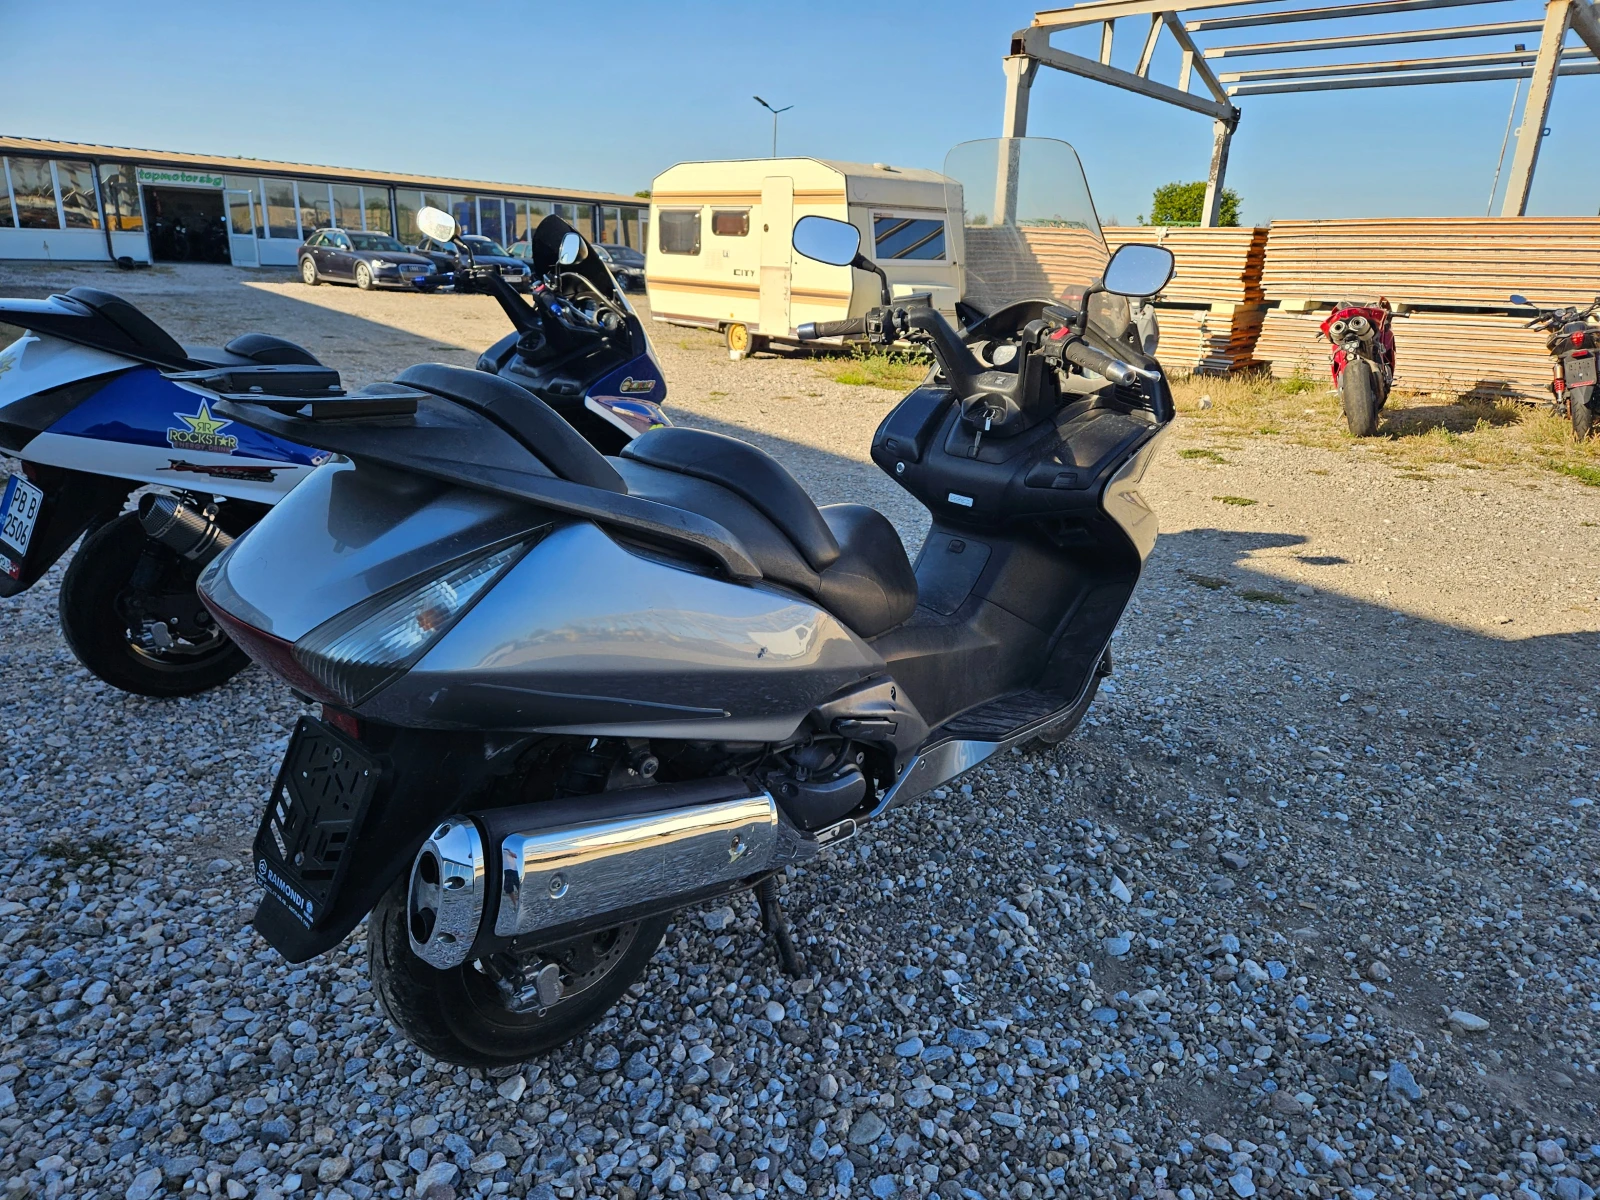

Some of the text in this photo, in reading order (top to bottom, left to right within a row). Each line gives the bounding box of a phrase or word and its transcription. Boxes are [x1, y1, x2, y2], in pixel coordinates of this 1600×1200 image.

[733, 268, 755, 277] CITY
[174, 441, 205, 450] ENERGY
[11, 487, 27, 513] PB
[27, 497, 36, 519] B
[3, 513, 28, 545] 2506
[268, 869, 304, 909] RAIMONDI
